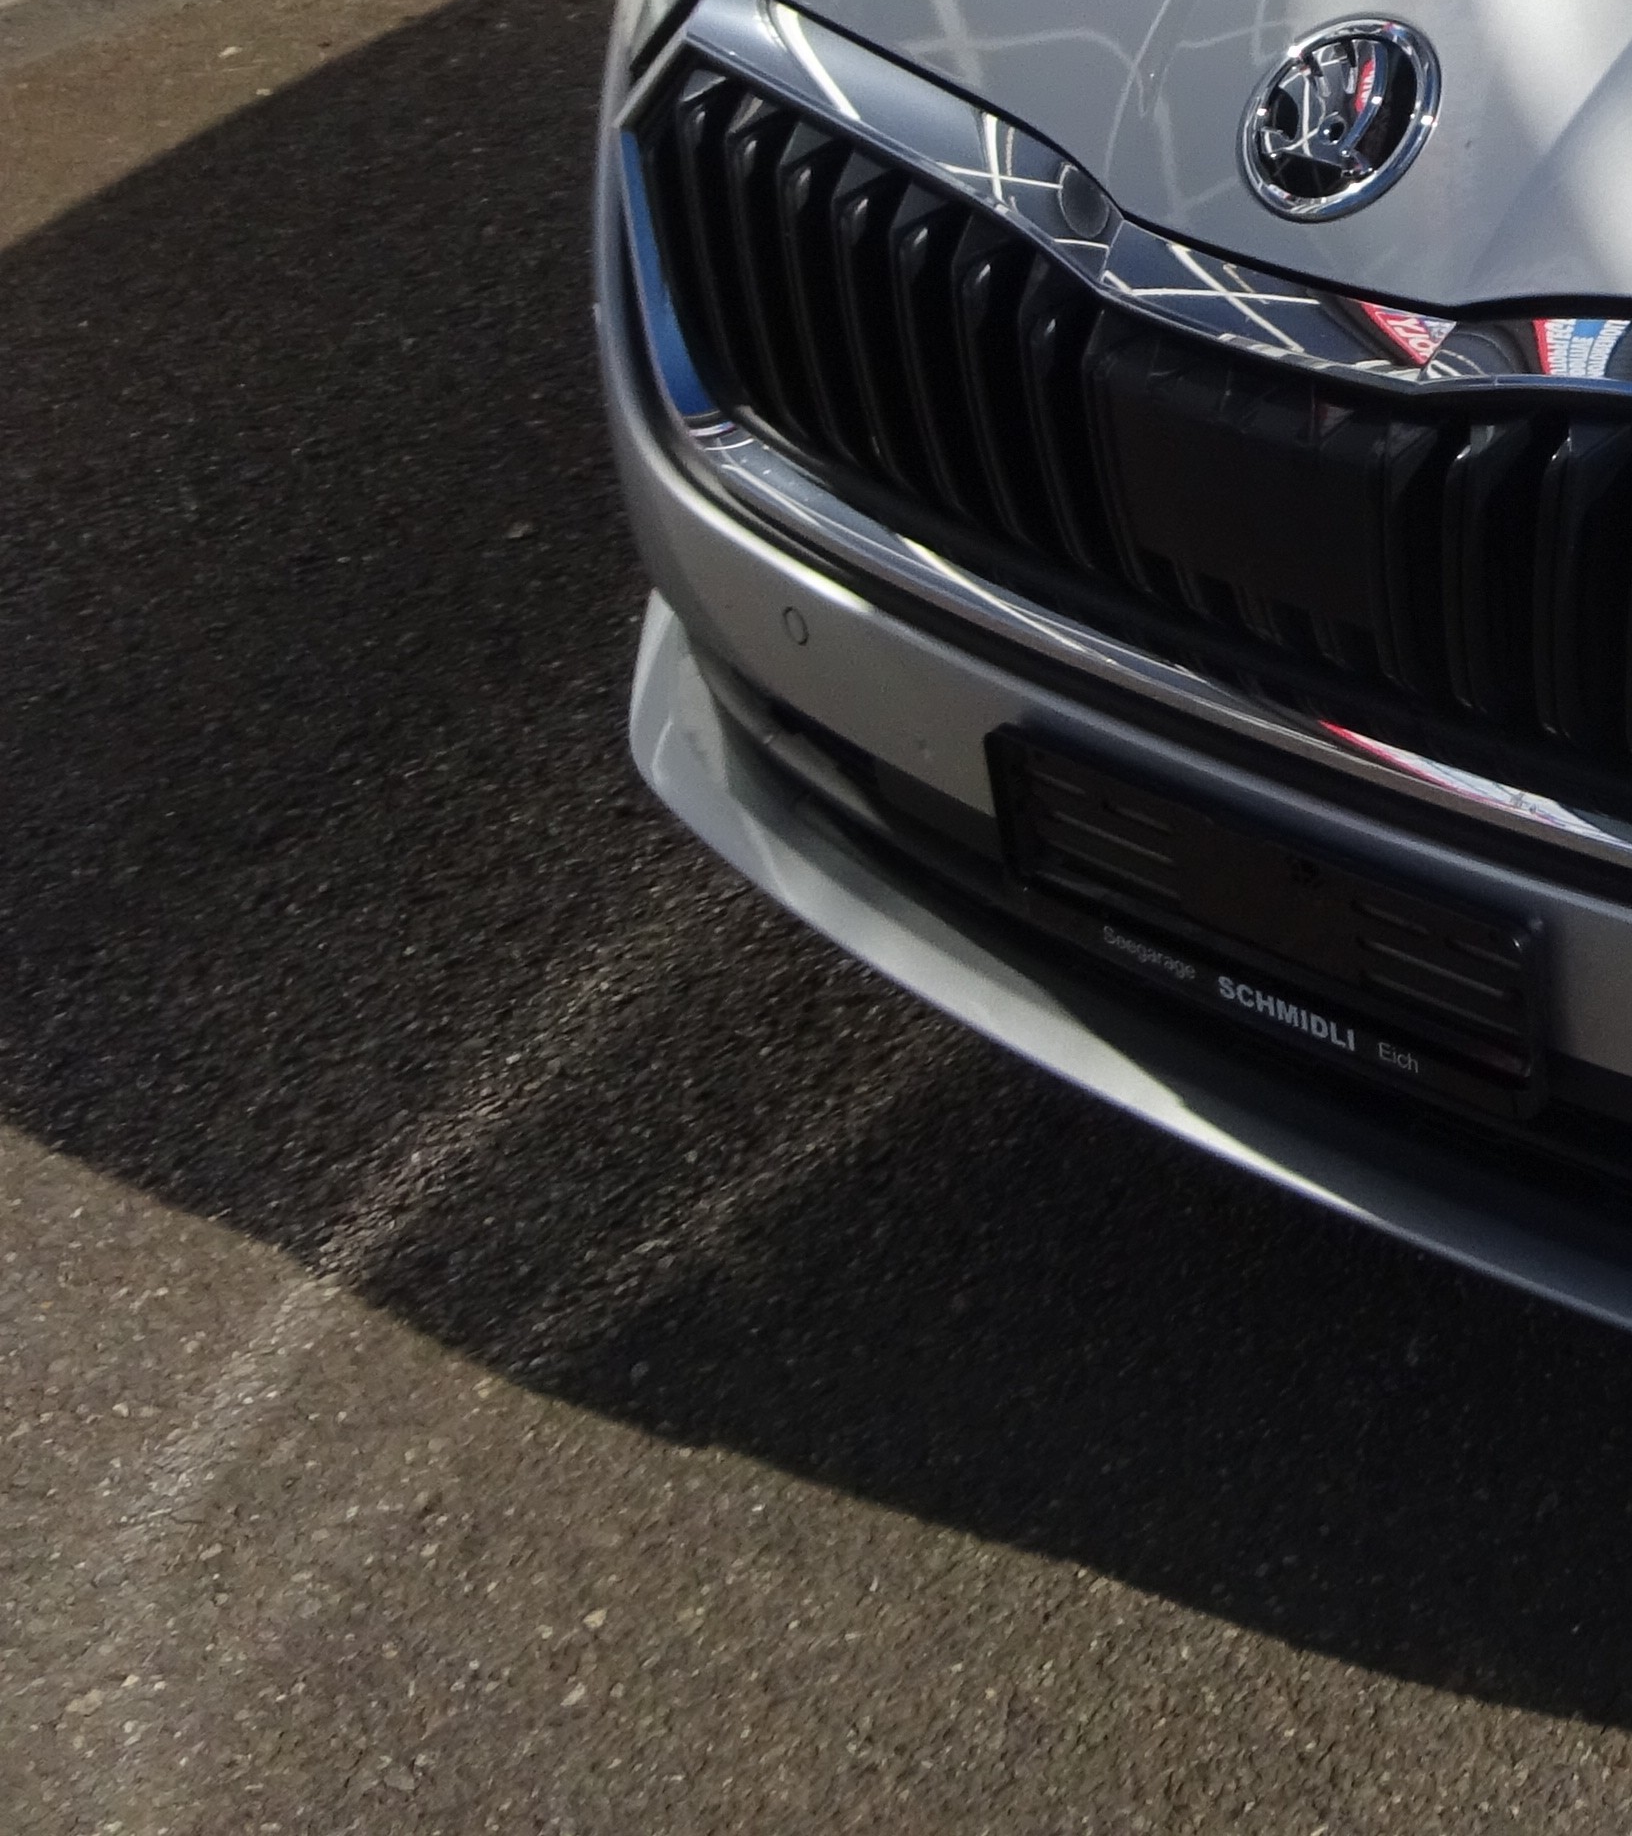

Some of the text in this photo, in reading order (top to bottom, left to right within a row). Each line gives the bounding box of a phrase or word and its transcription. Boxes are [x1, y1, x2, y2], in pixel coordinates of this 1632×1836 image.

[1102, 925, 1419, 1073] Seegarage SCHMIDLI Eich
